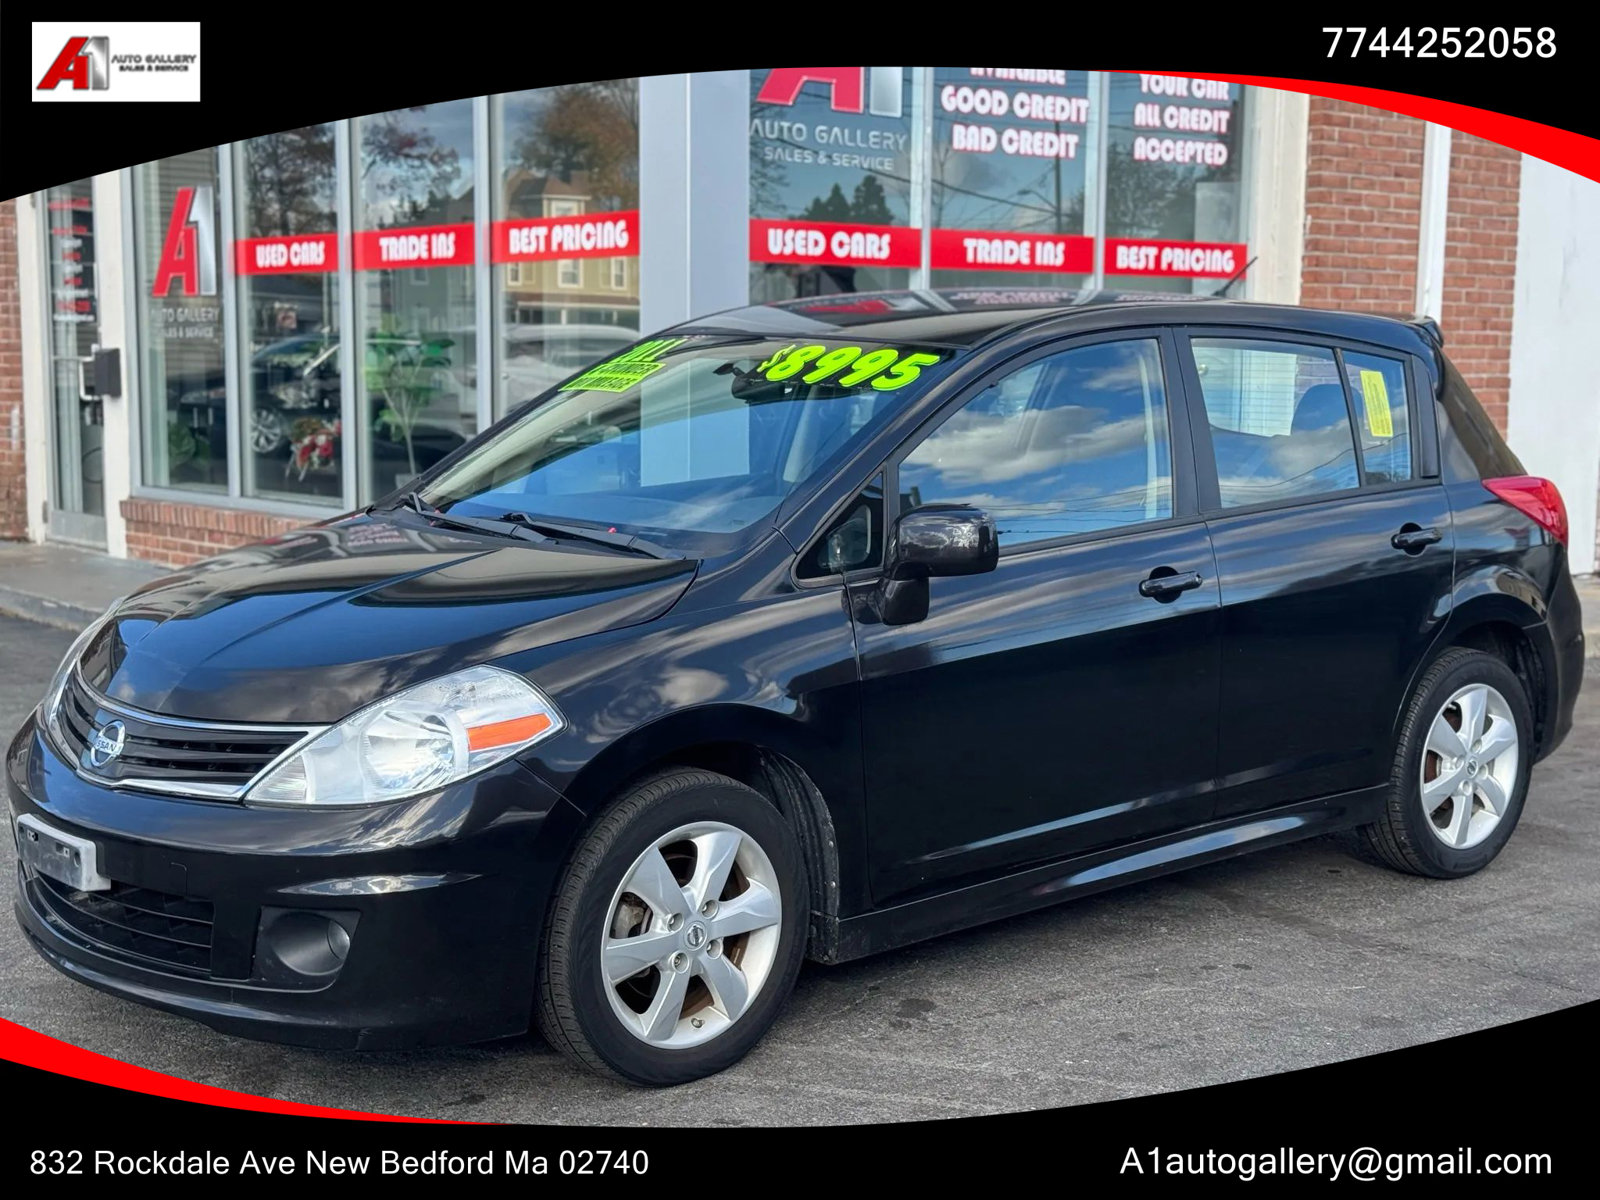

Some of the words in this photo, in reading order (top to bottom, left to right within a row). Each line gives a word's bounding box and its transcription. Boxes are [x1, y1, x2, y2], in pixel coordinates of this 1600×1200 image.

[1139, 73, 1188, 97] YOUR
[1191, 78, 1230, 100] CAR
[941, 85, 1009, 116] GOOD
[1013, 92, 1090, 123] CREDIT
[1134, 102, 1161, 127] ALL
[1163, 105, 1230, 133] CREDIT
[749, 118, 807, 142] AUTO
[815, 125, 908, 151] GALLERY
[952, 124, 998, 152] BAD
[1001, 128, 1079, 159] CREDIT
[764, 147, 813, 164] SALES
[817, 150, 827, 165] &
[832, 153, 894, 171] SERVICE
[1133, 136, 1228, 166] ACCEPTED
[152, 185, 216, 297] A1
[379, 233, 429, 262] TRADE
[431, 232, 456, 260] INS
[509, 226, 549, 254] BEST
[551, 219, 629, 252] PRICING
[767, 228, 826, 257] USED
[830, 231, 891, 260] CARS
[255, 243, 288, 268] USED
[290, 240, 325, 267] CARS
[963, 238, 1031, 266] TRADE
[1035, 241, 1066, 267] INS
[1116, 245, 1158, 270] BEST
[1160, 247, 1236, 274] PRICING
[757, 344, 940, 391] $8995
